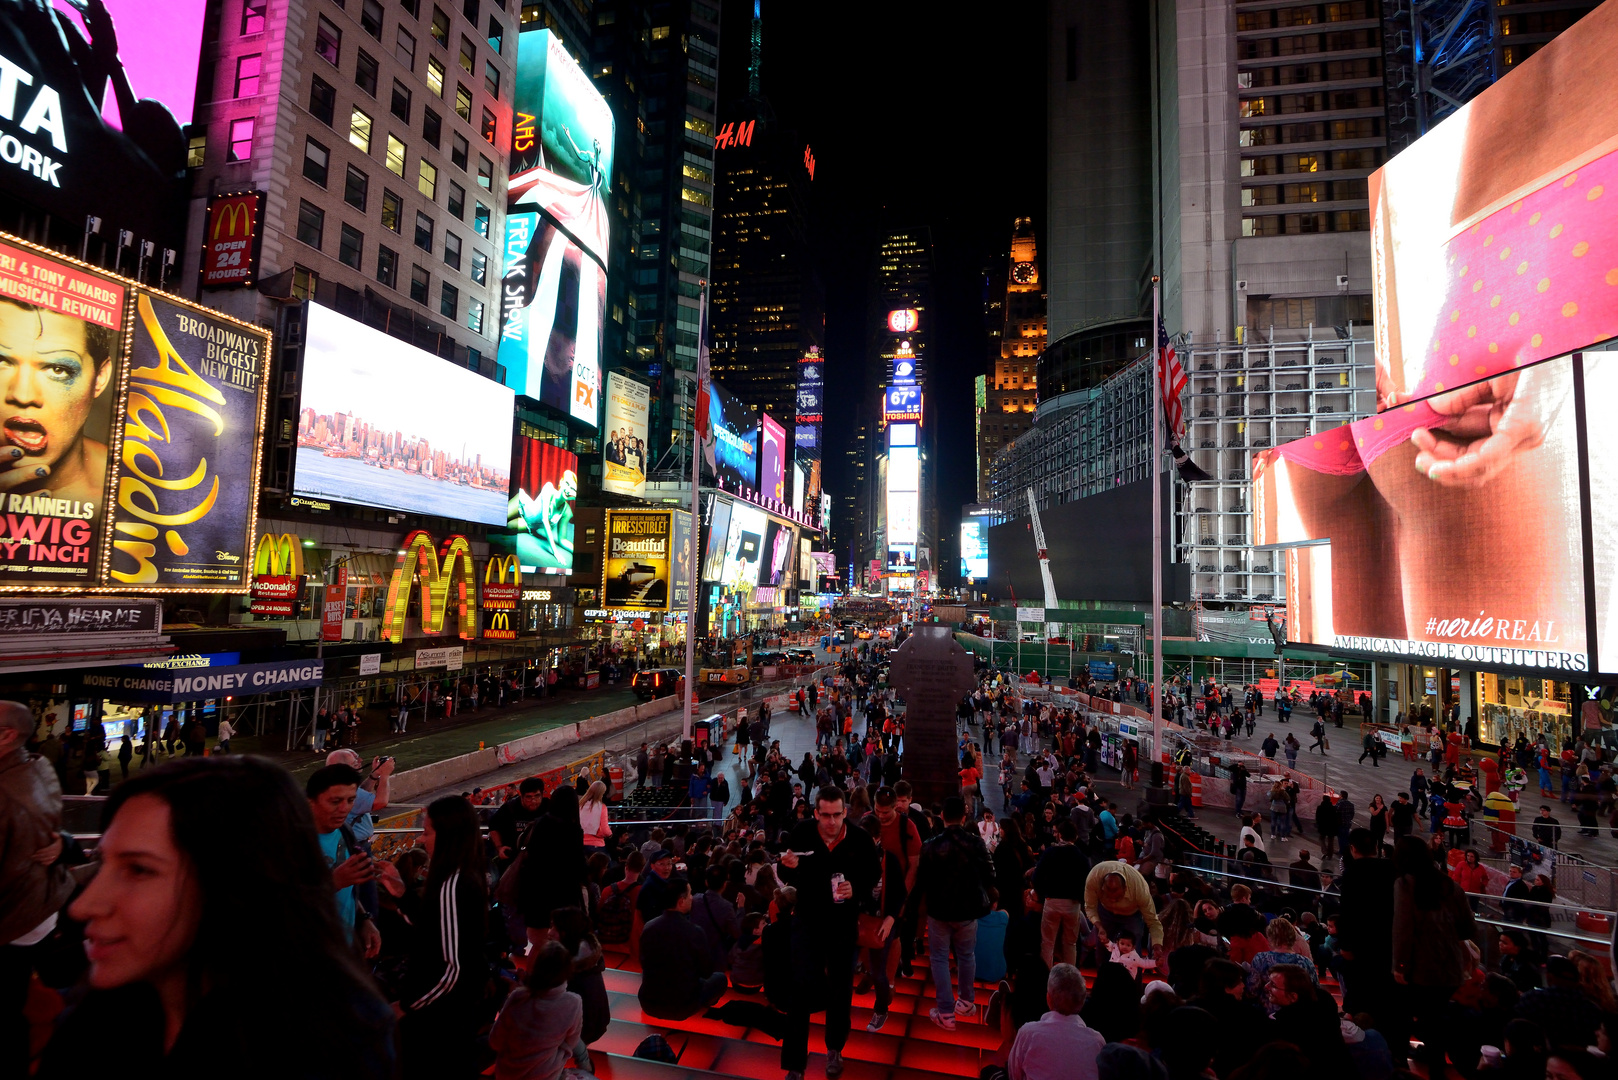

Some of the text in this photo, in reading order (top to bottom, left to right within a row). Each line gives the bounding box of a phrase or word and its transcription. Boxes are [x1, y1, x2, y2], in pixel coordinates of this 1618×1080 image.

[514, 111, 536, 151] AHS
[715, 120, 755, 150] H&M
[215, 241, 246, 252] OPEN
[217, 251, 241, 267] 24
[208, 267, 247, 280] HOURS
[503, 217, 529, 341] FREAK SHOW
[19, 262, 28, 275] 4
[32, 265, 66, 287] TONY
[68, 279, 117, 305] AWARDS
[23, 276, 58, 292] INCLUDING
[62, 297, 114, 326] REVIVAL
[207, 342, 257, 372] BIGGEST
[201, 358, 228, 381] NEW
[576, 363, 590, 381] OCT
[576, 380, 594, 408] FX
[8, 494, 95, 519] RANNELLS
[28, 544, 90, 563] INCH
[612, 538, 666, 553] Beautiful
[215, 550, 240, 564] Disney
[251, 580, 296, 591] McDonald's
[521, 591, 551, 600] EXPRESS
[325, 601, 344, 611] JERSEY
[613, 610, 651, 618] LUGGAGE
[68, 607, 112, 624] HEAR
[115, 608, 141, 623] ME
[327, 612, 342, 621] BOYS
[1333, 635, 1587, 672] AMERICAN EAGLE OUTFITTERS
[171, 658, 211, 668] EXCHANGE
[83, 674, 171, 692] MONEY CHANGE
[173, 666, 324, 694] MONEY CHANGE
[709, 673, 720, 681] CAT
